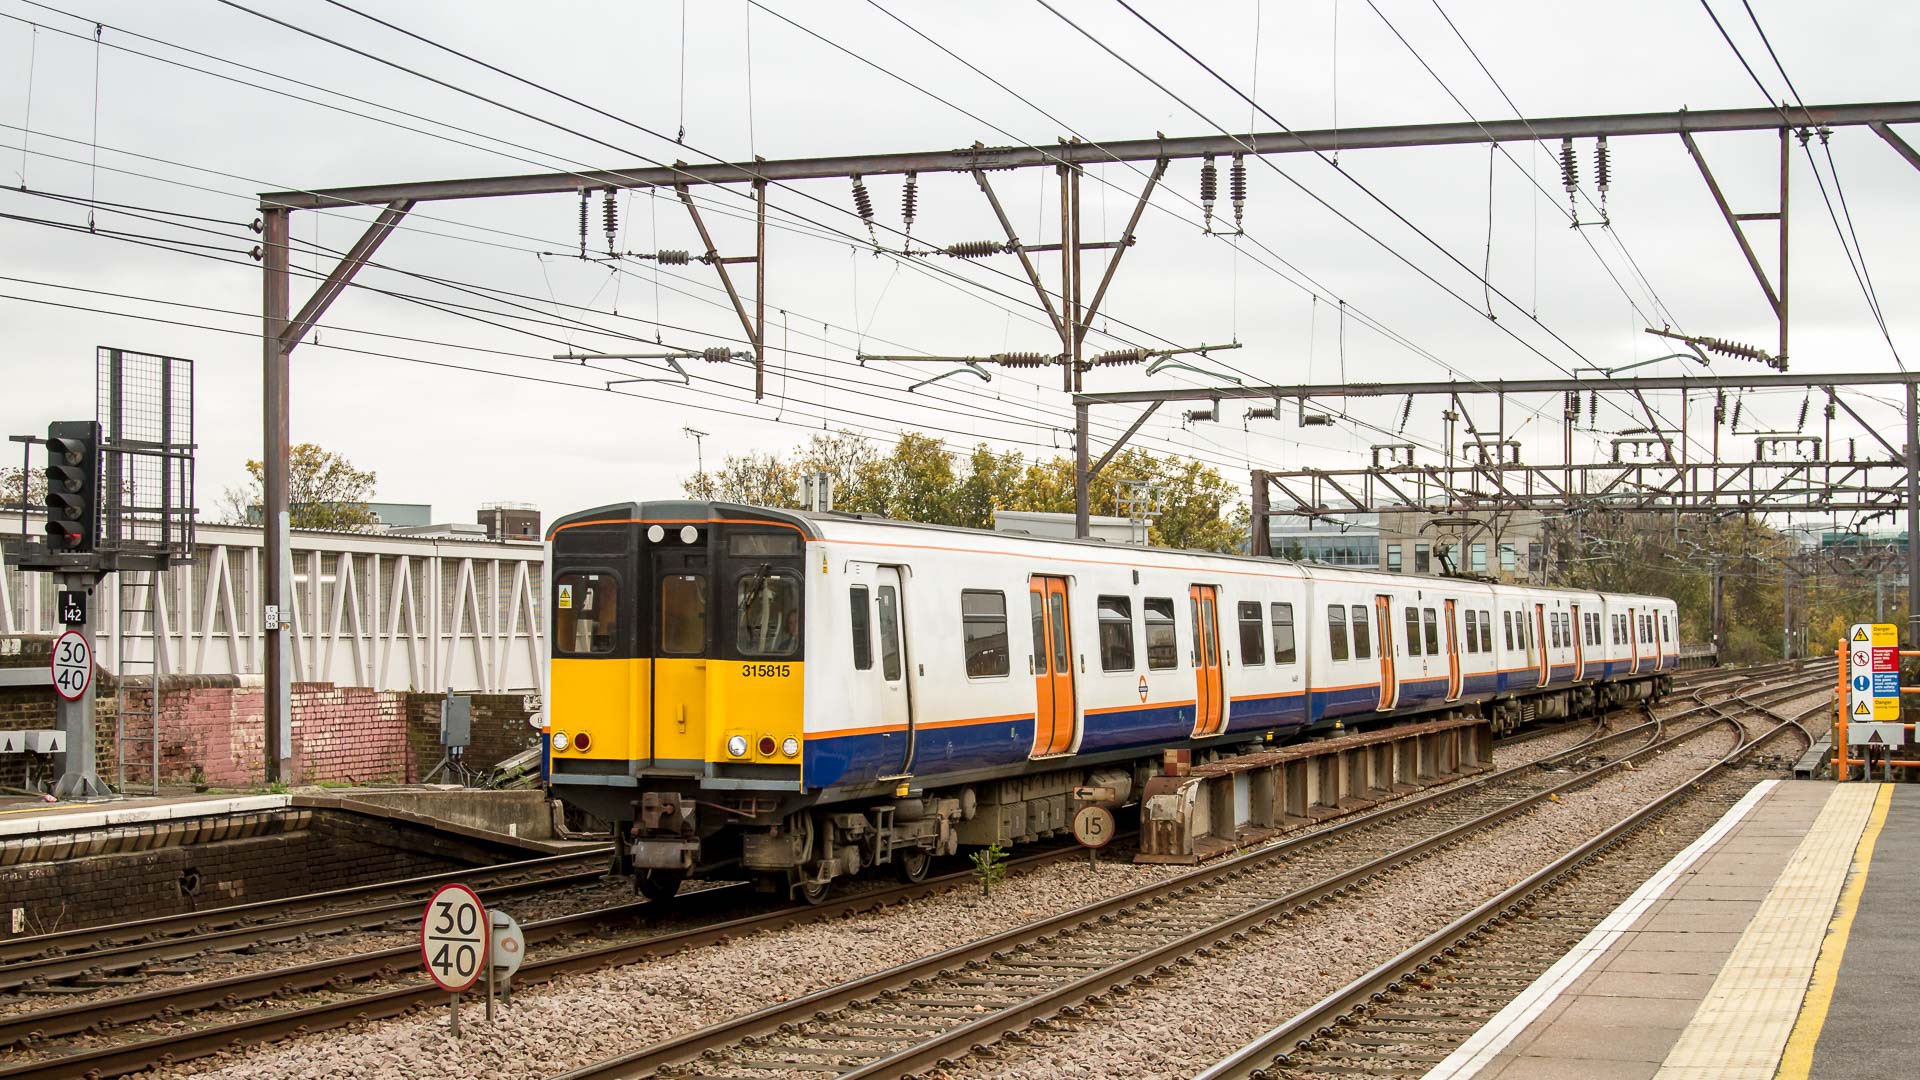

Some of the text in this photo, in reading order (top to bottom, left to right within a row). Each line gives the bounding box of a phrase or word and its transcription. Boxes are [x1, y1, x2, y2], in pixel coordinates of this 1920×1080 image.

[68, 594, 76, 605] L
[64, 608, 82, 621] 142
[60, 641, 86, 664] 30
[57, 668, 84, 691] 40
[742, 664, 790, 678] 315815
[1085, 816, 1102, 835] 15
[434, 901, 477, 935] 30
[431, 943, 477, 977] 40
